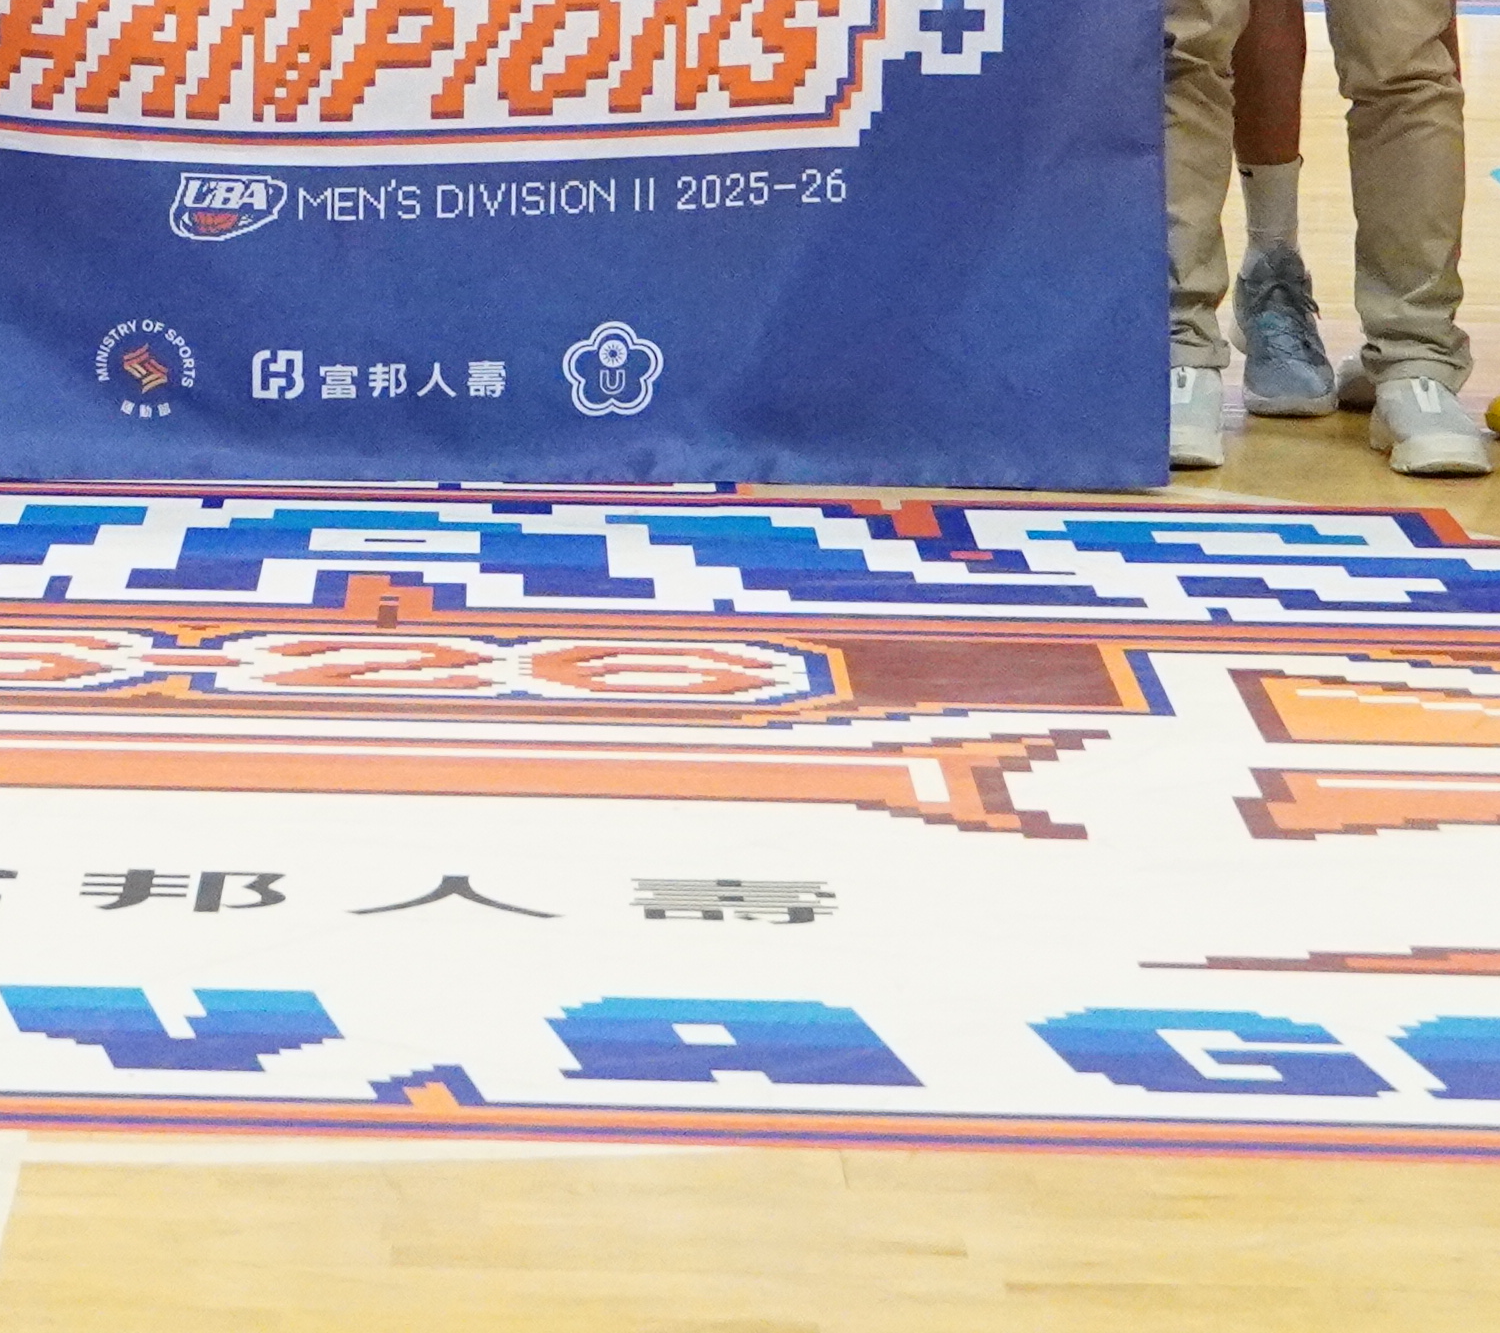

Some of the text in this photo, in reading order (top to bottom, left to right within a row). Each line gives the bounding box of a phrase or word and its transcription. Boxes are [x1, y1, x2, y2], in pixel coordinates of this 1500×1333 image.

[184, 169, 849, 222] UBA MEN'S DIVISION II 2025-26
[95, 318, 197, 389] MINISTRY OF SPORTS
[319, 359, 507, 400] 富邦人壽
[540, 993, 928, 1090] A
